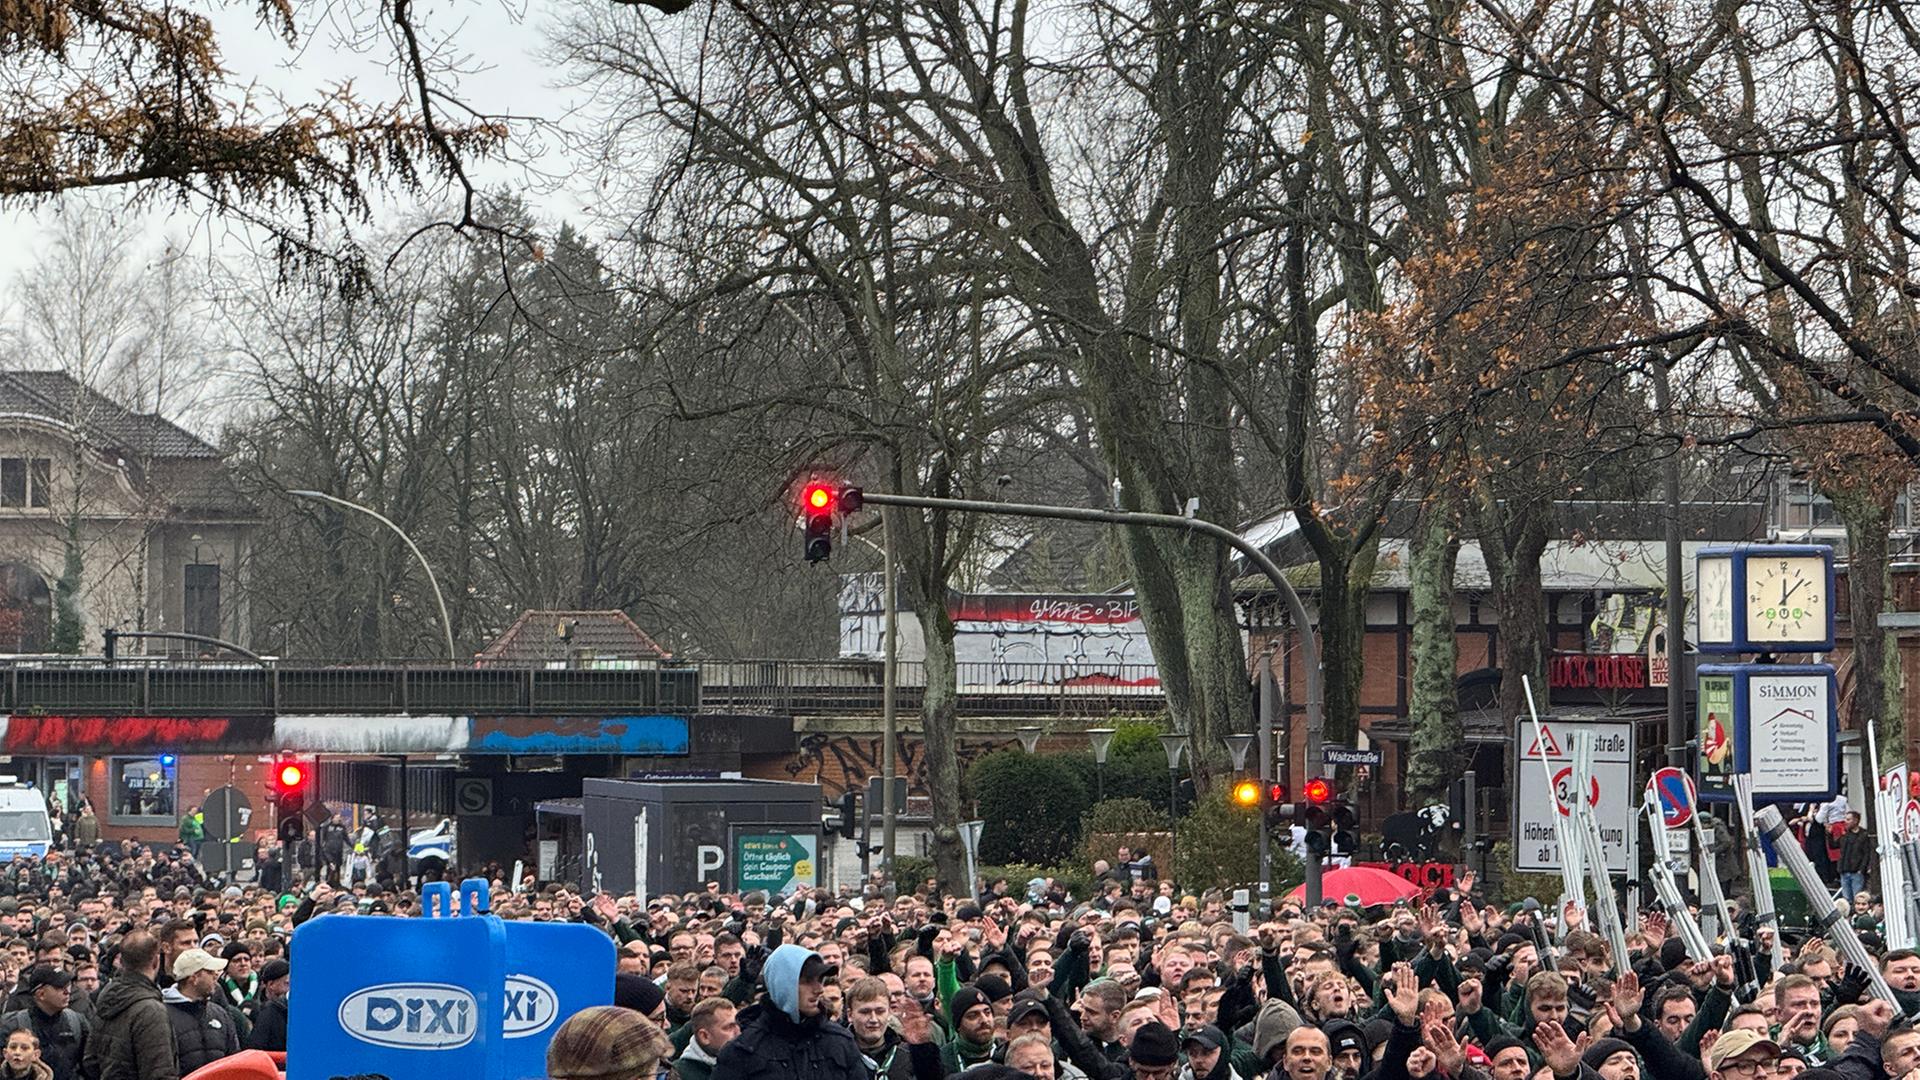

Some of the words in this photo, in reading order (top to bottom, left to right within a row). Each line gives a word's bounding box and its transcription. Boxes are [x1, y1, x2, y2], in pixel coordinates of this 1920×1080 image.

[1549, 656, 1589, 688] LOCK
[1593, 656, 1644, 688] HOUSE
[1565, 733, 1626, 752] Wstraße
[1328, 750, 1379, 763] Waitzstraße
[1524, 821, 1623, 847] Höhenkung
[765, 851, 791, 863] täglich
[1538, 844, 1550, 862] ab
[697, 845, 725, 883] P
[743, 862, 759, 871] dein
